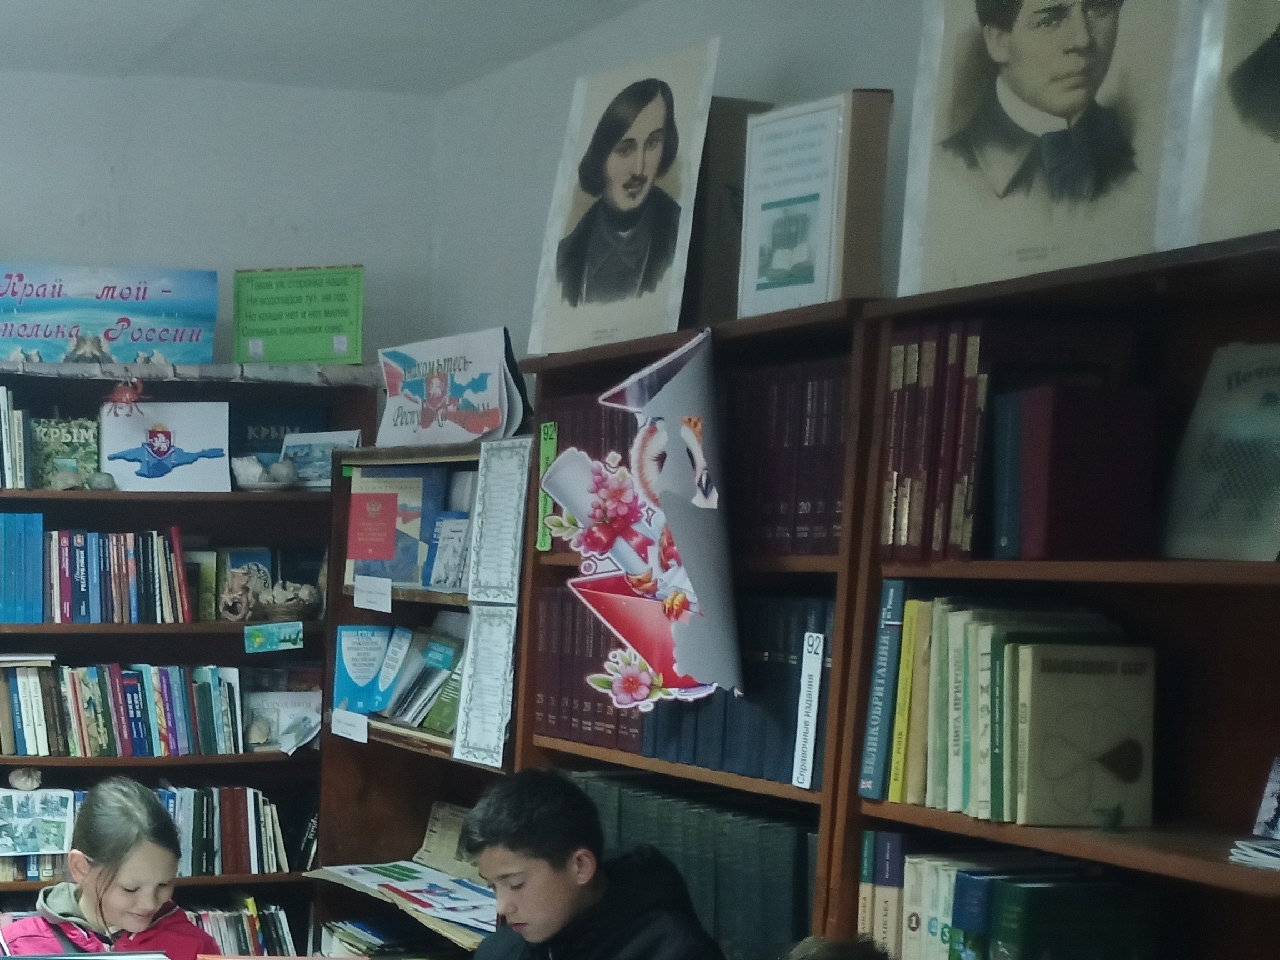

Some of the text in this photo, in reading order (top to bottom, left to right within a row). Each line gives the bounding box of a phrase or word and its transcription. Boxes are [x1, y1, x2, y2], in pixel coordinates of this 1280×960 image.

[96, 282, 149, 301] мой
[103, 317, 203, 343] России
[35, 428, 95, 443] КРЫМ
[806, 634, 822, 655] 92
[795, 673, 815, 784] Справочные издания
[951, 714, 963, 757] КНИГА
